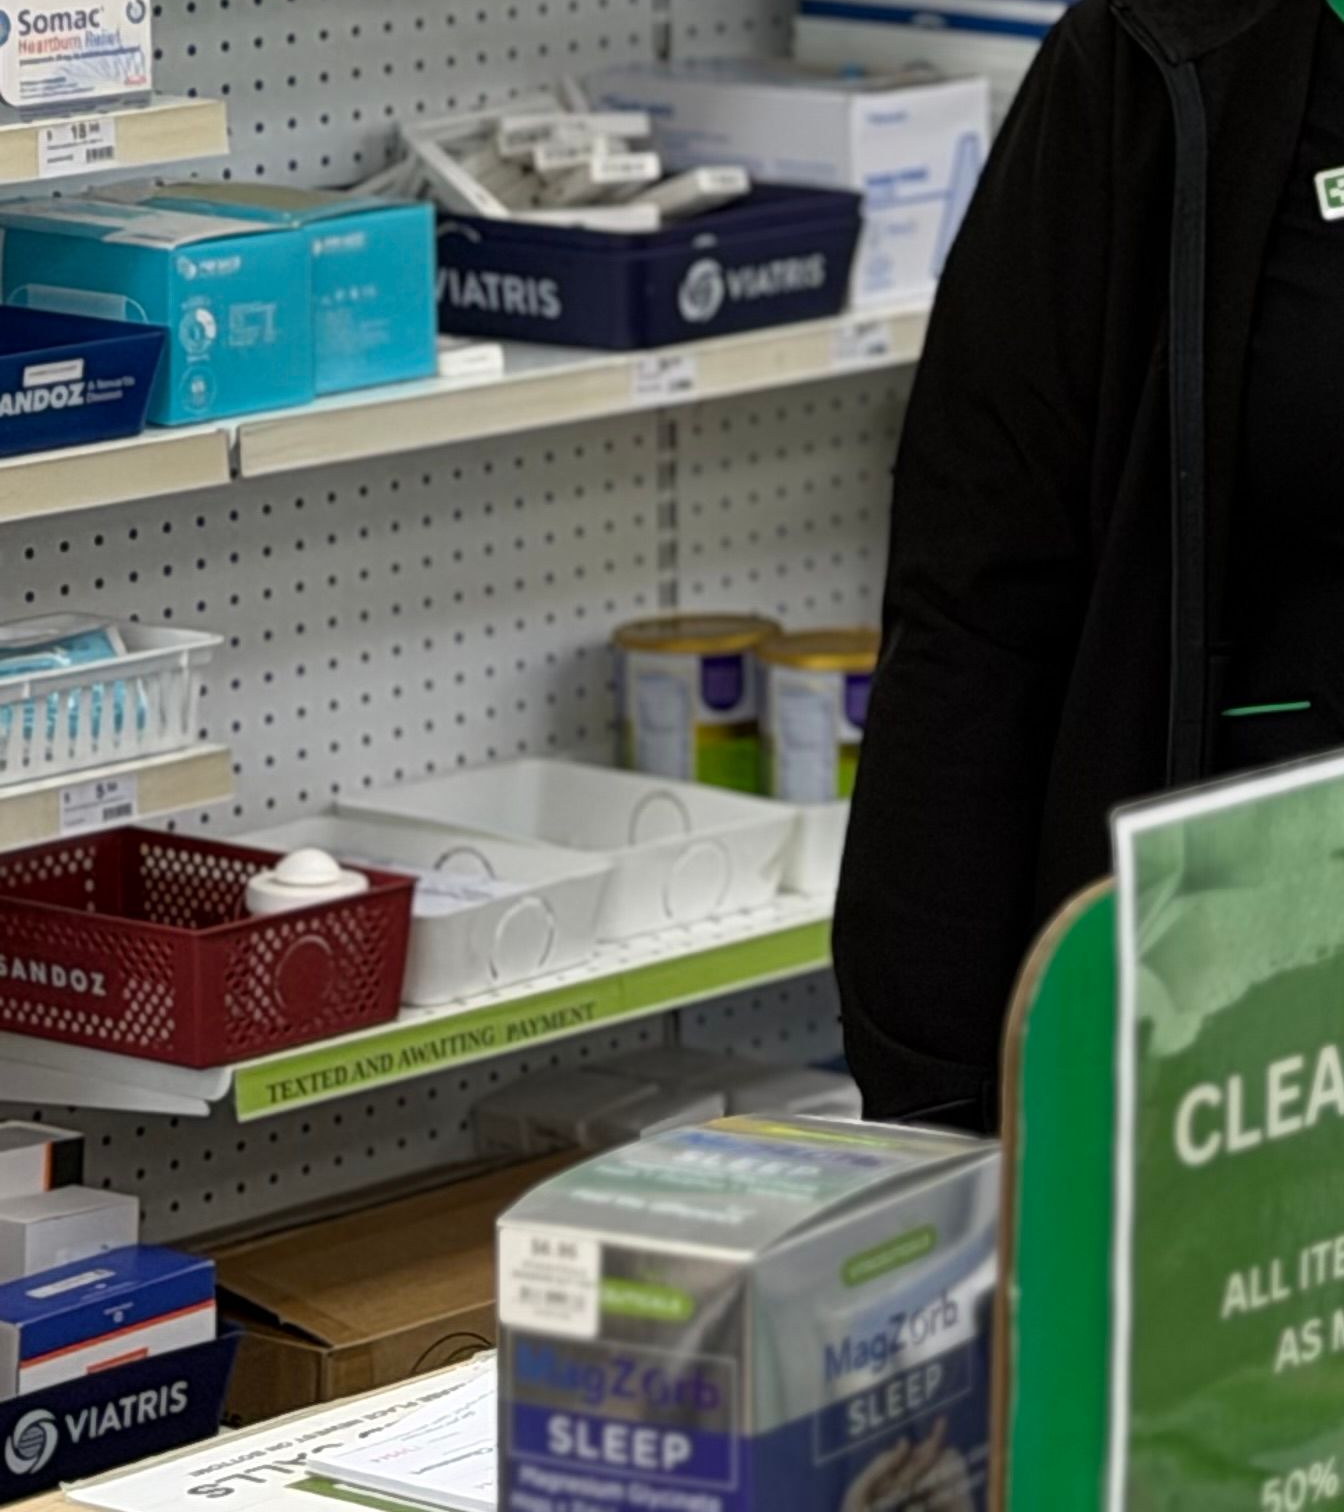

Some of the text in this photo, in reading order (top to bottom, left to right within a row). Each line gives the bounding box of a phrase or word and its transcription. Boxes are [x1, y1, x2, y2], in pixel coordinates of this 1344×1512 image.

[18, 8, 101, 37] Somac
[18, 34, 82, 55] Heartburn
[724, 253, 826, 303] VIATRIS
[266, 1000, 598, 1104] TEXTED AND AWAITING PAYMENT
[1220, 1255, 1290, 1320] ALL
[824, 1288, 959, 1385] MagZorb
[1273, 1321, 1321, 1374] AS
[64, 1380, 190, 1445] VIATRIS
[847, 1361, 943, 1438] SLEEP
[547, 1414, 693, 1472] SLEEP
[1261, 1456, 1338, 1512] 50%
